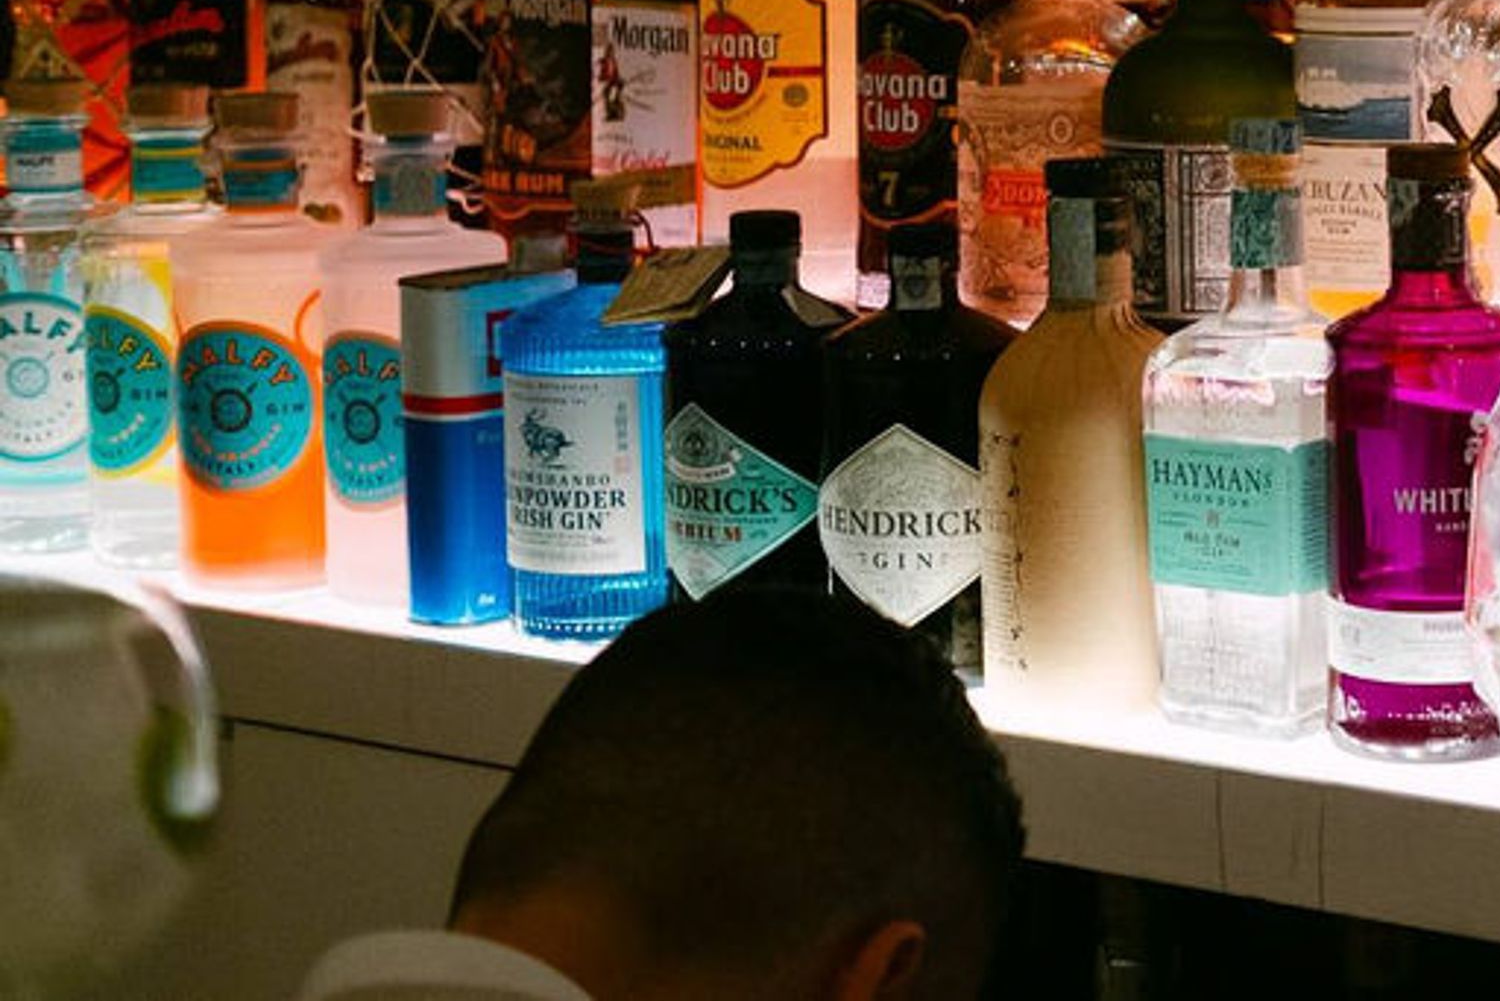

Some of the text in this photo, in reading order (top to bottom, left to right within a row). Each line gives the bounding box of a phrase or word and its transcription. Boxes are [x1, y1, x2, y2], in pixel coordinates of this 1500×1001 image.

[611, 16, 690, 57] Morgan
[862, 102, 919, 133] Club
[878, 172, 899, 206] 7
[560, 510, 603, 530] GIN
[872, 551, 934, 570] GIN
